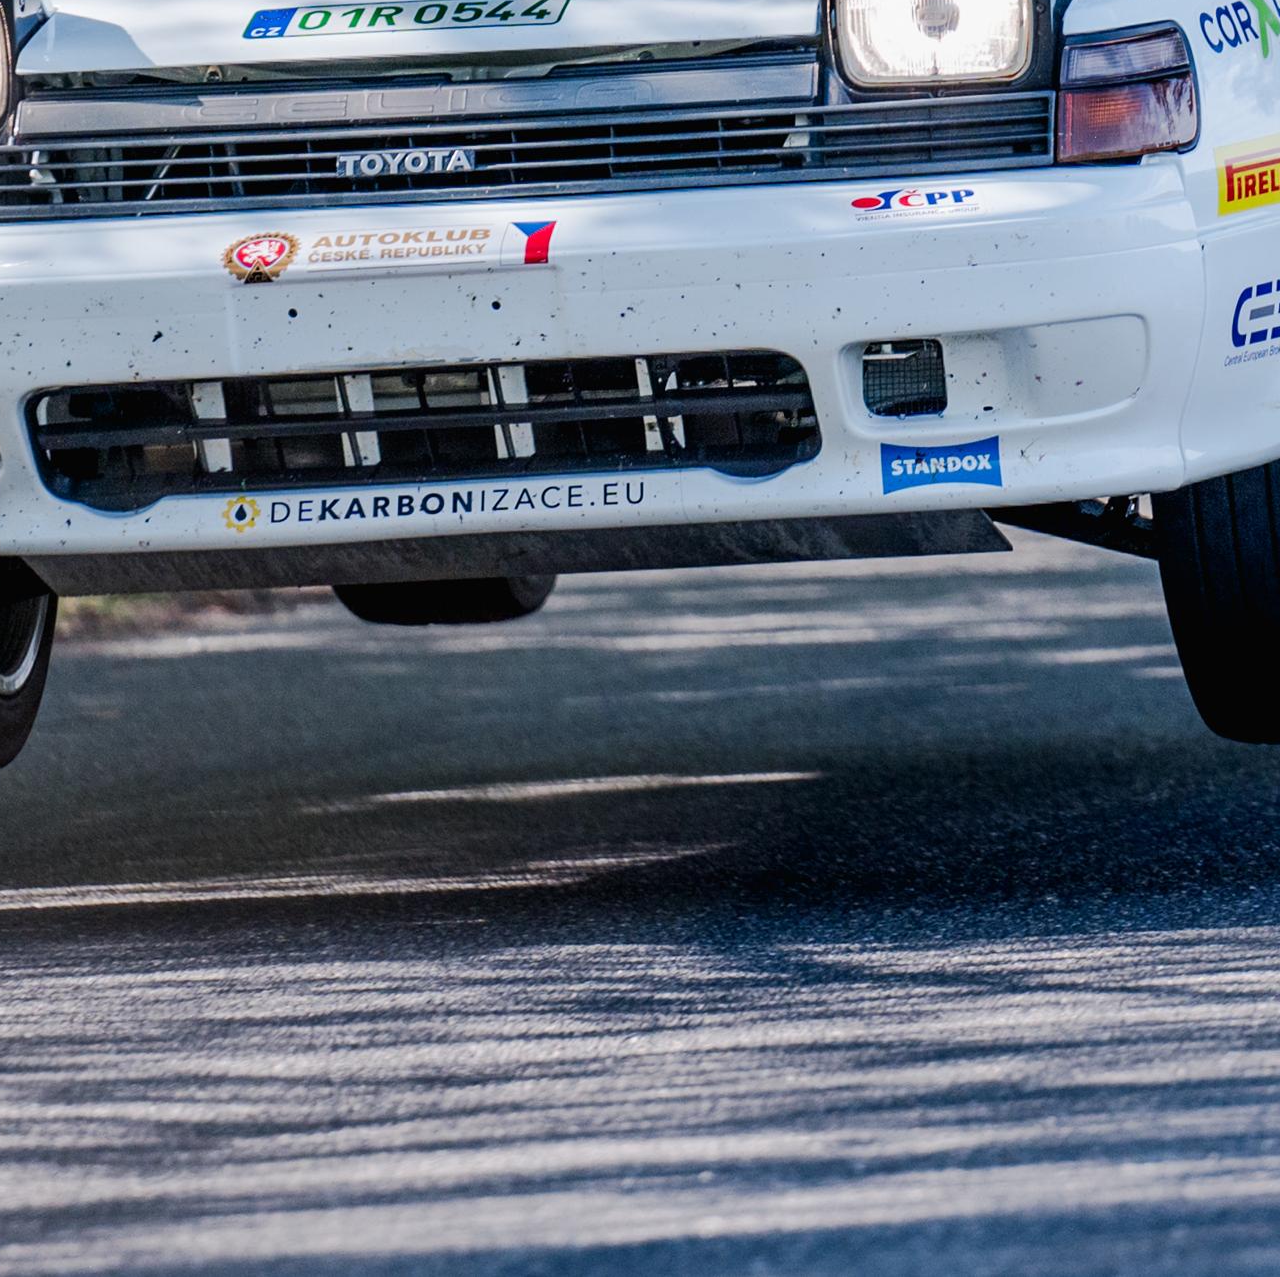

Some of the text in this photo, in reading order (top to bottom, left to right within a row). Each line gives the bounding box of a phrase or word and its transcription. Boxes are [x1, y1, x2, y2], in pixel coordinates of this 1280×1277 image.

[298, 6, 403, 31] 01R
[250, 26, 281, 37] CZ
[339, 150, 471, 176] TOYOTA
[898, 189, 975, 207] ČPP
[312, 229, 492, 248] AUTOKLUB
[308, 243, 487, 263] ČESKÉ REPUBLIKY
[1224, 352, 1243, 367] Central
[891, 454, 993, 476] STANDOX
[270, 481, 646, 523] DEKARBONIZACE.EU
